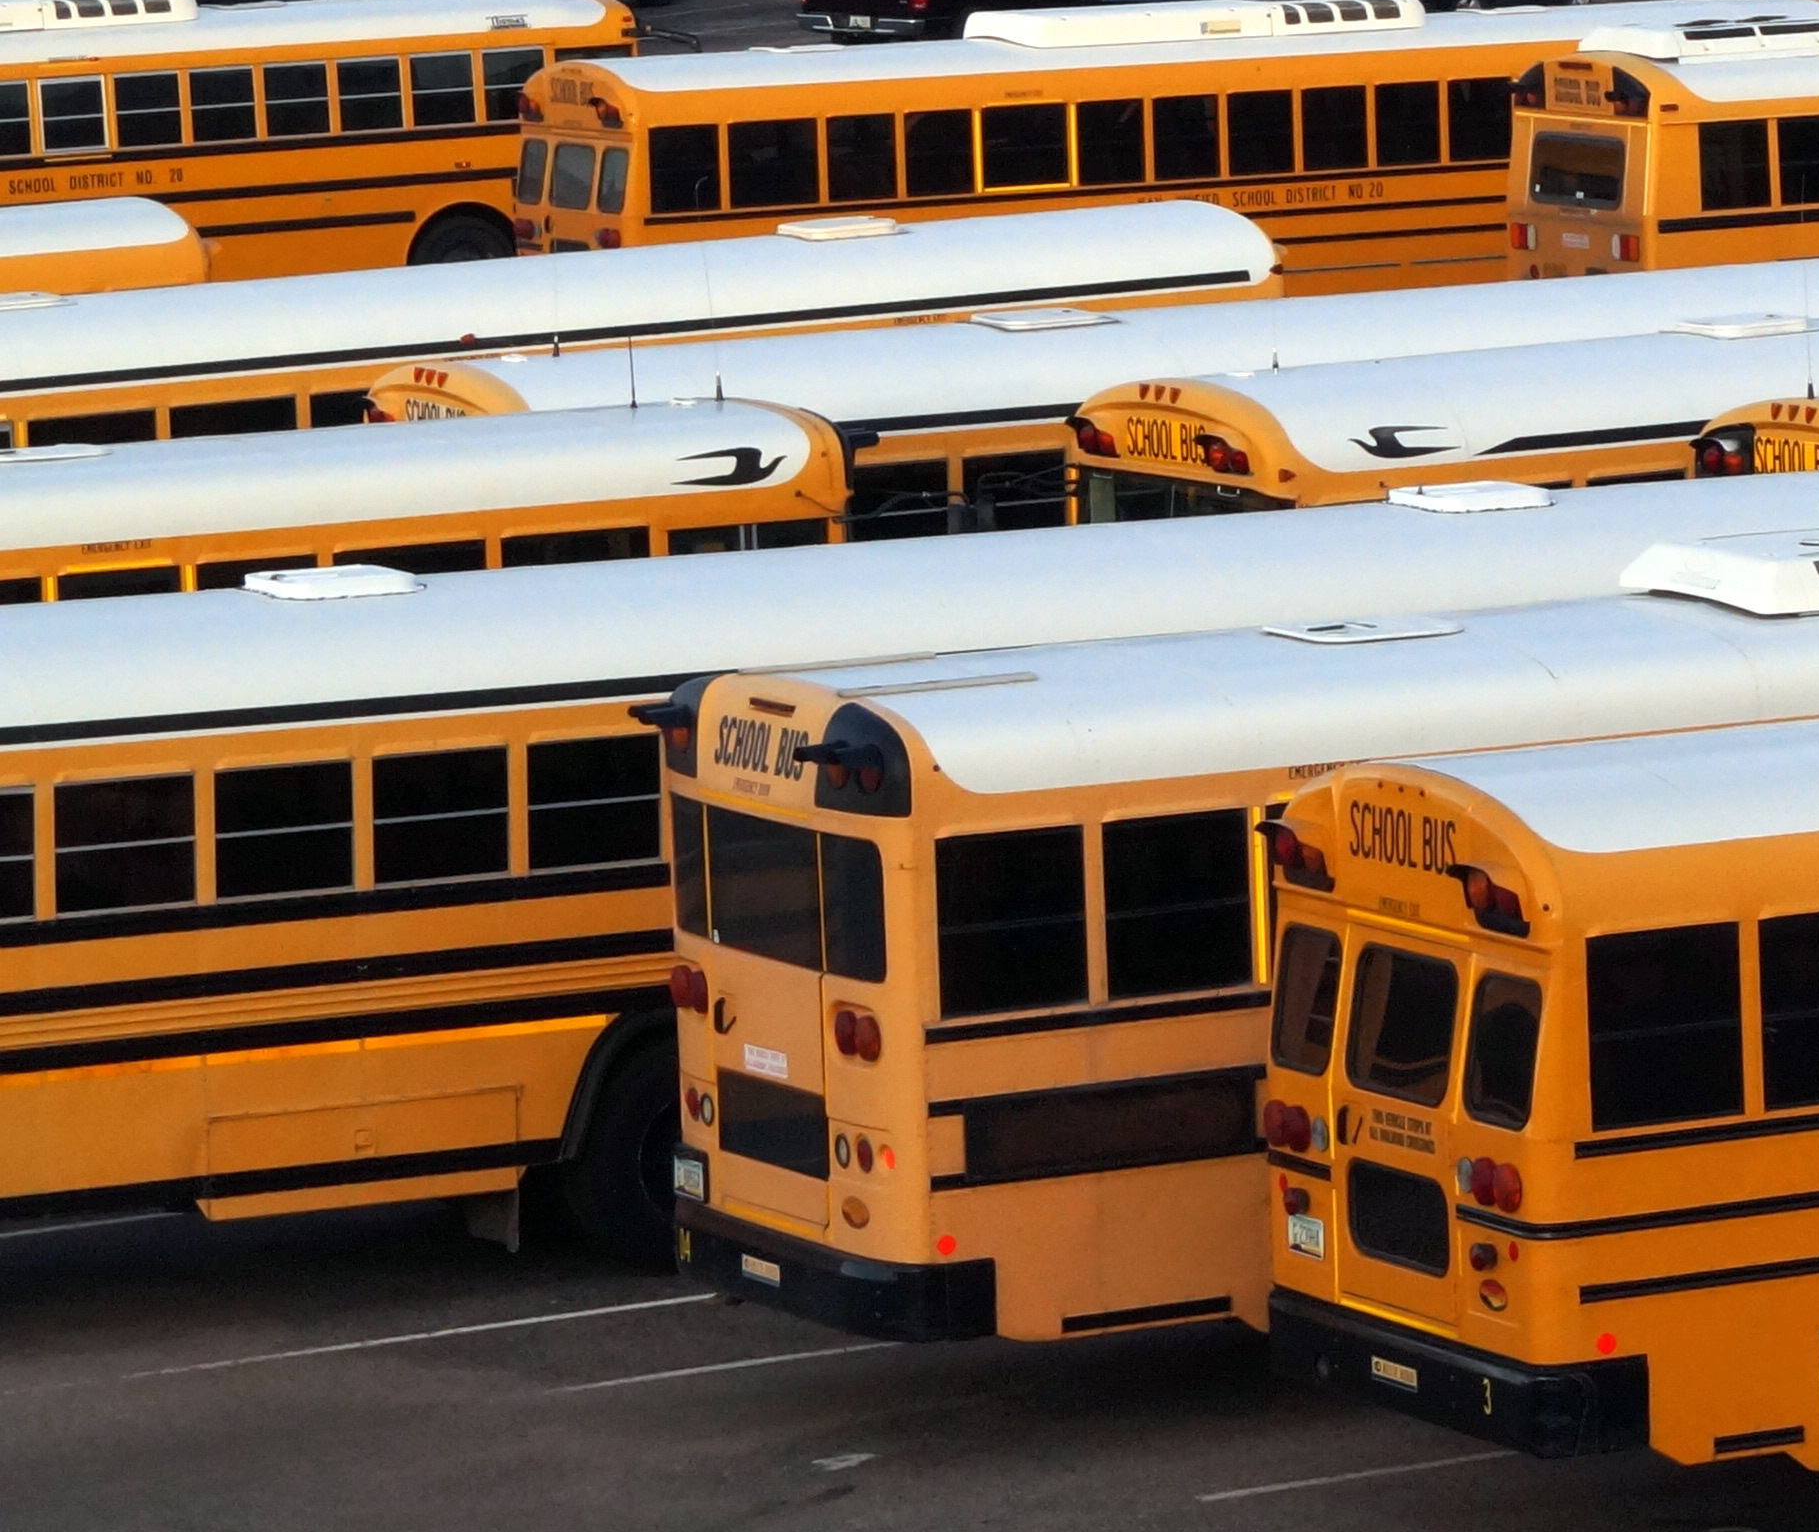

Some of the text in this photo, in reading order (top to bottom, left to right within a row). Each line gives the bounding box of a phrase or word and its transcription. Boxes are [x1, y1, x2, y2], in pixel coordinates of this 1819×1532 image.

[9, 177, 56, 195] SCHOOL
[70, 172, 125, 190] DISTRICT
[1232, 189, 1277, 207] SCHOOL
[1286, 185, 1336, 204] DISTRICT
[1369, 182, 1384, 198] 20
[1127, 416, 1178, 462] SCHOOL
[1755, 436, 1805, 473] SCHOOL
[714, 715, 810, 782] SCHOOL BUS
[1349, 800, 1457, 876] SCHOOL BUS
